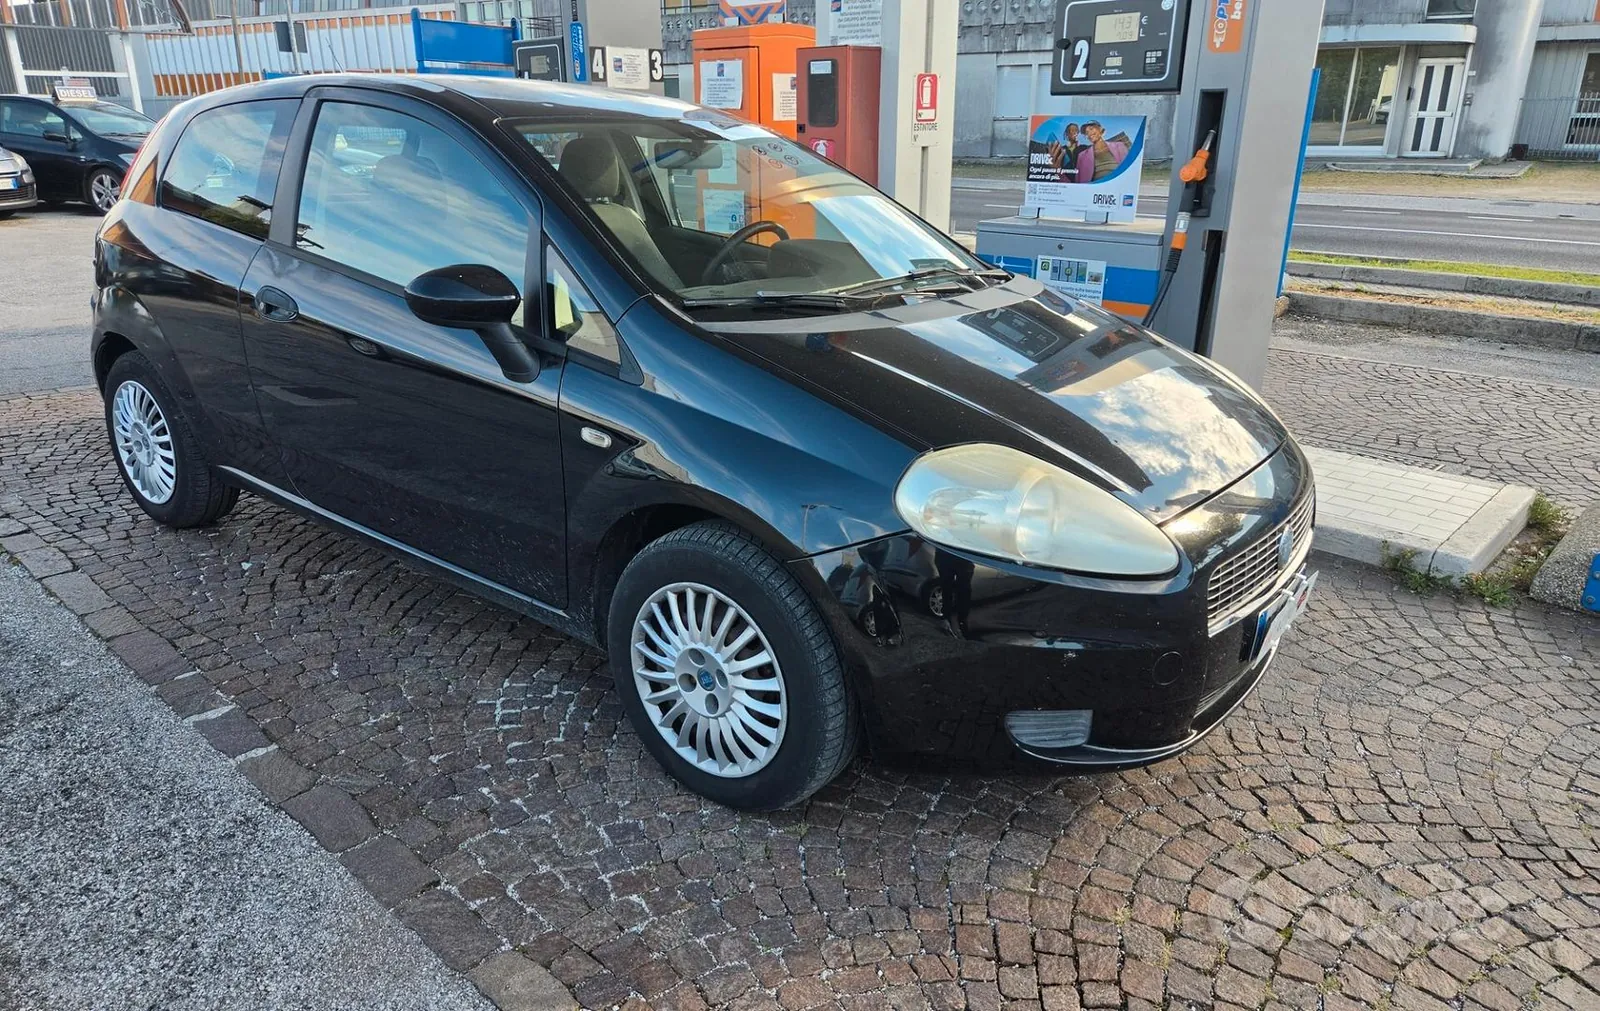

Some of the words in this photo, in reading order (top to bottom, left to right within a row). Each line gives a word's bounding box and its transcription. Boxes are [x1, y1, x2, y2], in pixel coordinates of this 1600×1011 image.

[593, 48, 605, 79] 4
[651, 50, 663, 80] 3
[1072, 40, 1089, 78] 2
[60, 89, 94, 98] DIESEL
[914, 123, 938, 132] ESTINTORE
